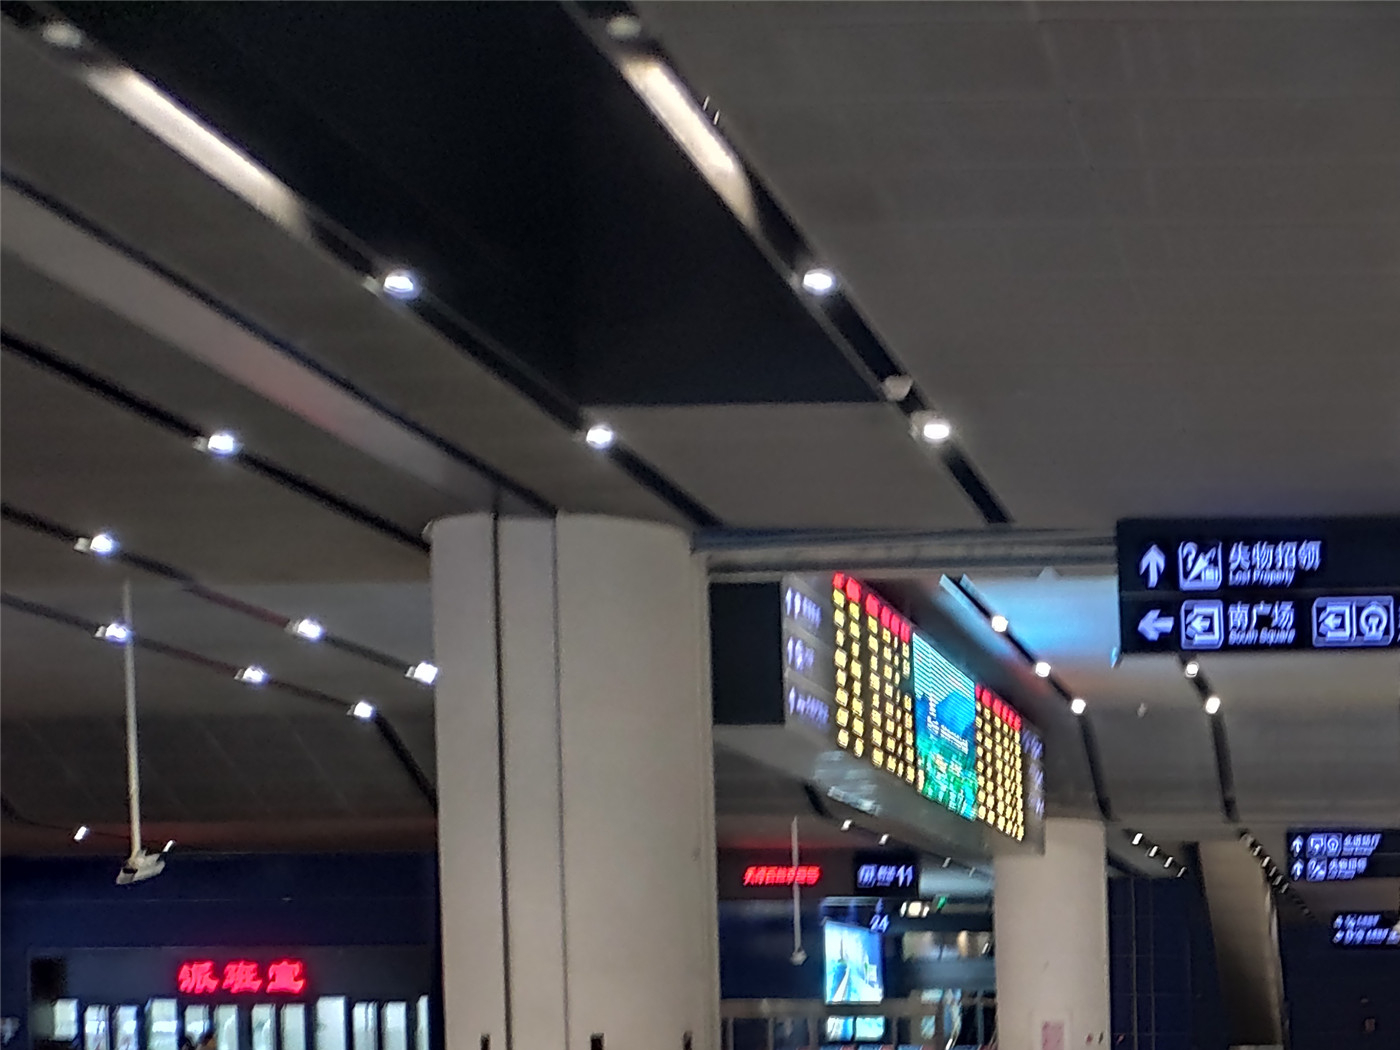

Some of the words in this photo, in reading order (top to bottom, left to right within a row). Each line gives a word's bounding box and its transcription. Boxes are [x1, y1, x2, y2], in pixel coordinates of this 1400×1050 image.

[1229, 540, 1321, 570] 失物招领
[1228, 601, 1295, 631] 南广场
